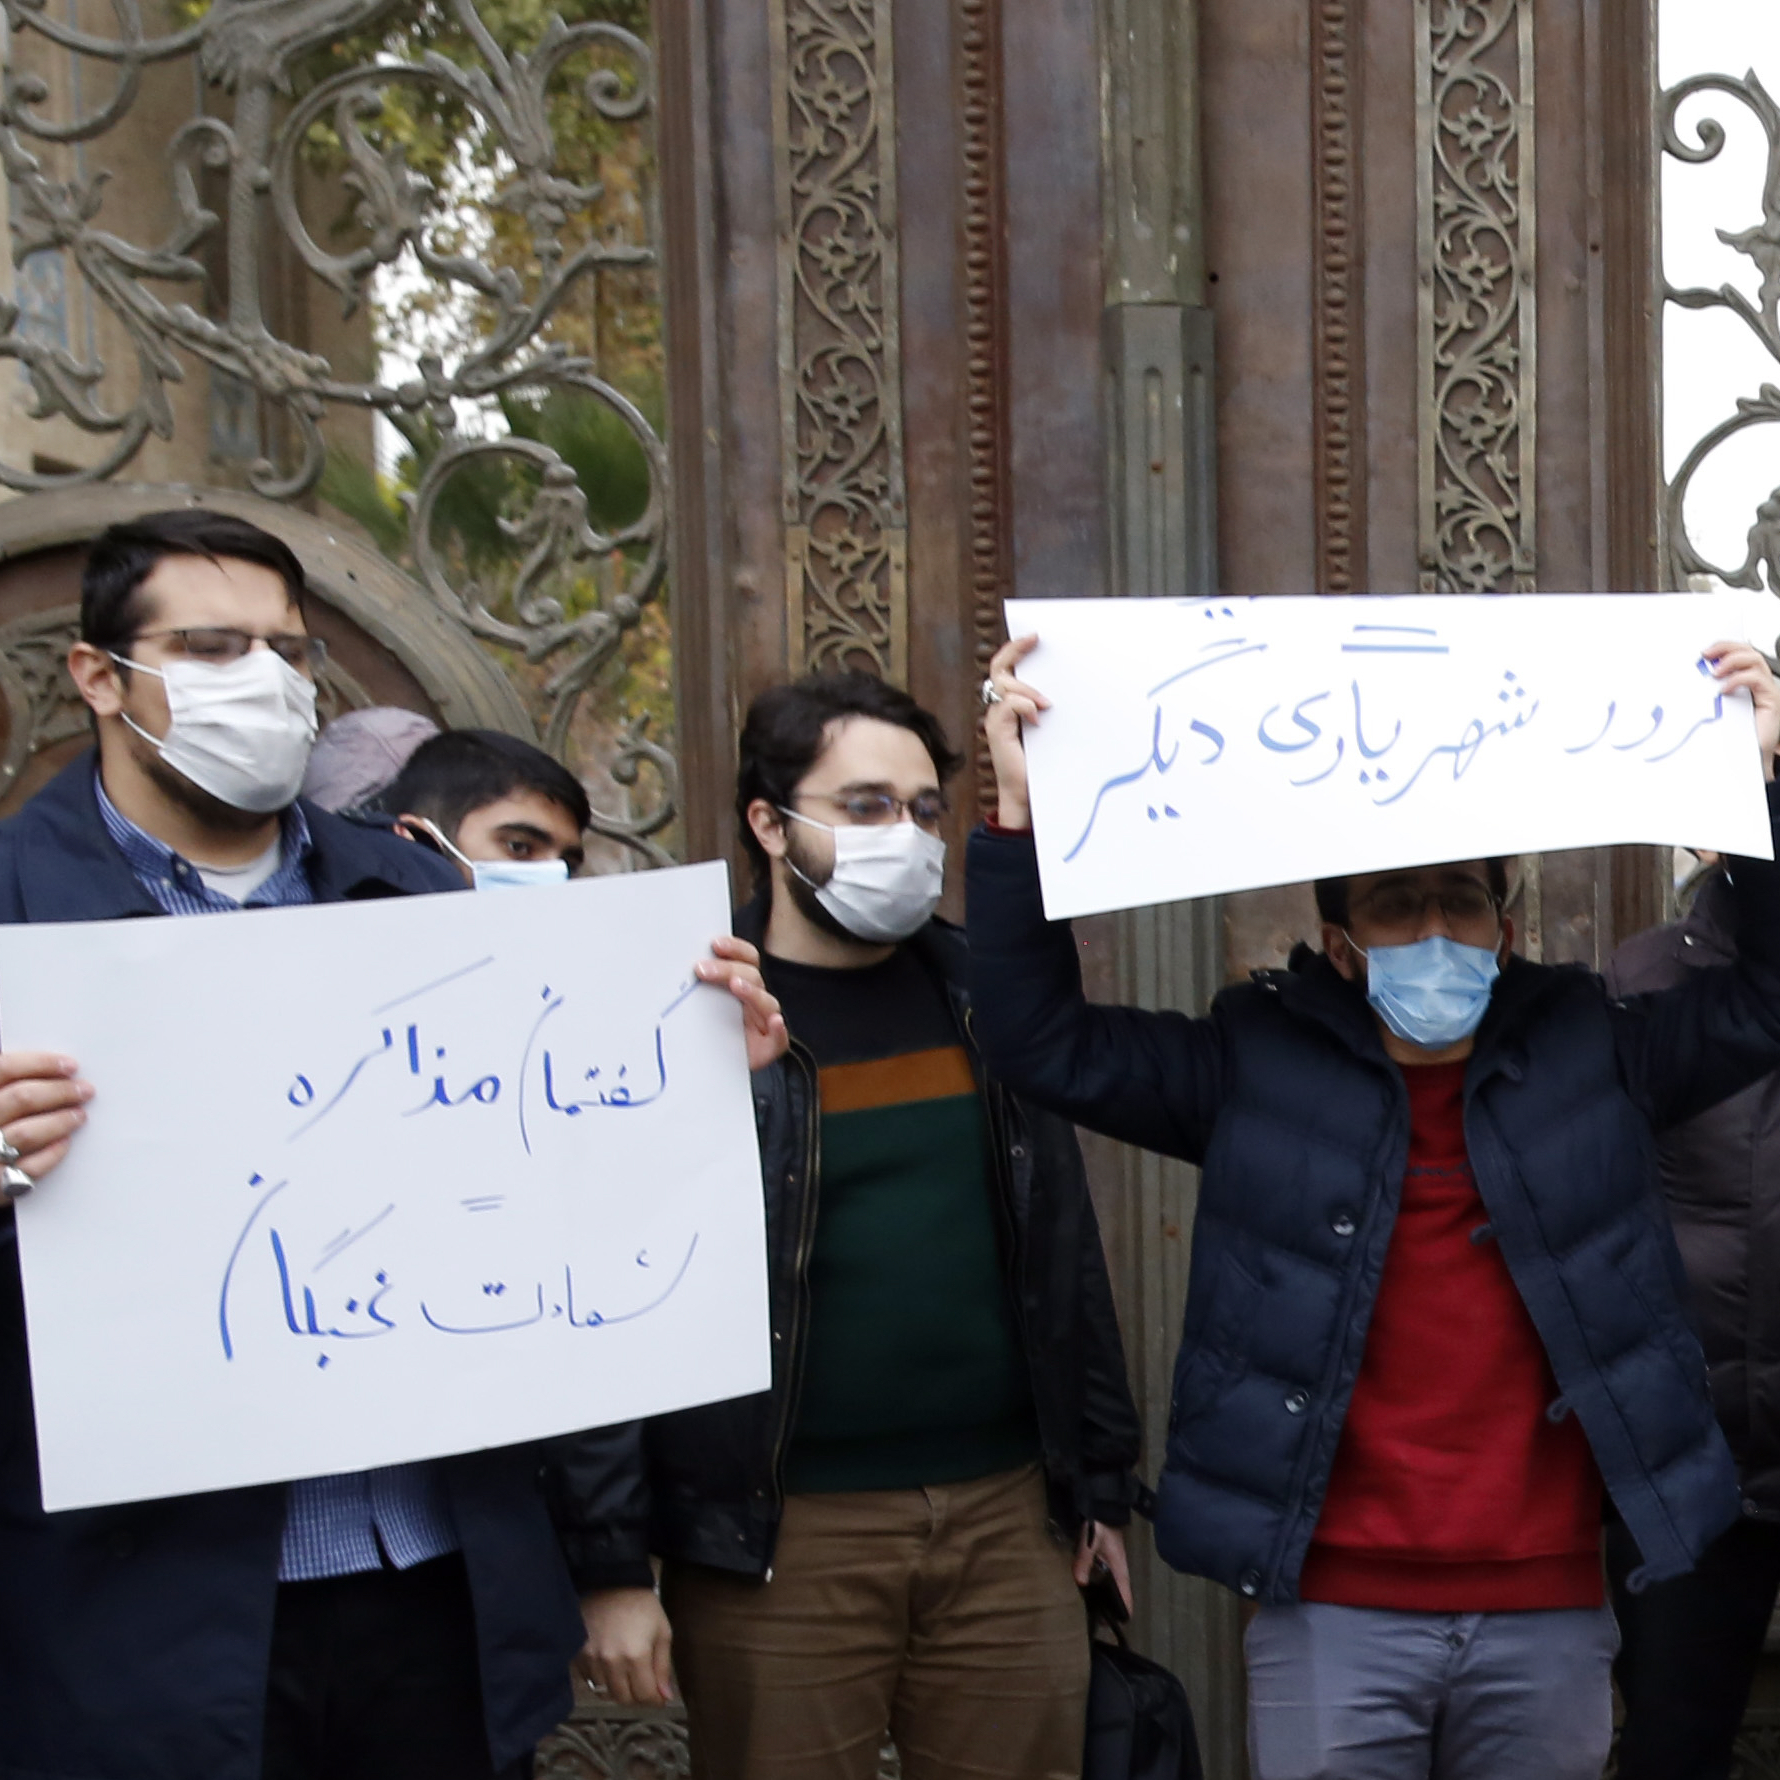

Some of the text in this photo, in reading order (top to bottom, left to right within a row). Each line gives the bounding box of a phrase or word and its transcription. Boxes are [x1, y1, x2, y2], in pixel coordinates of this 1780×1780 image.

[1062, 637, 1270, 864] دیگر
[1257, 669, 1541, 808] شهریاری
[286, 957, 502, 1142] مذاکره
[218, 1172, 397, 1369] نخبگان
